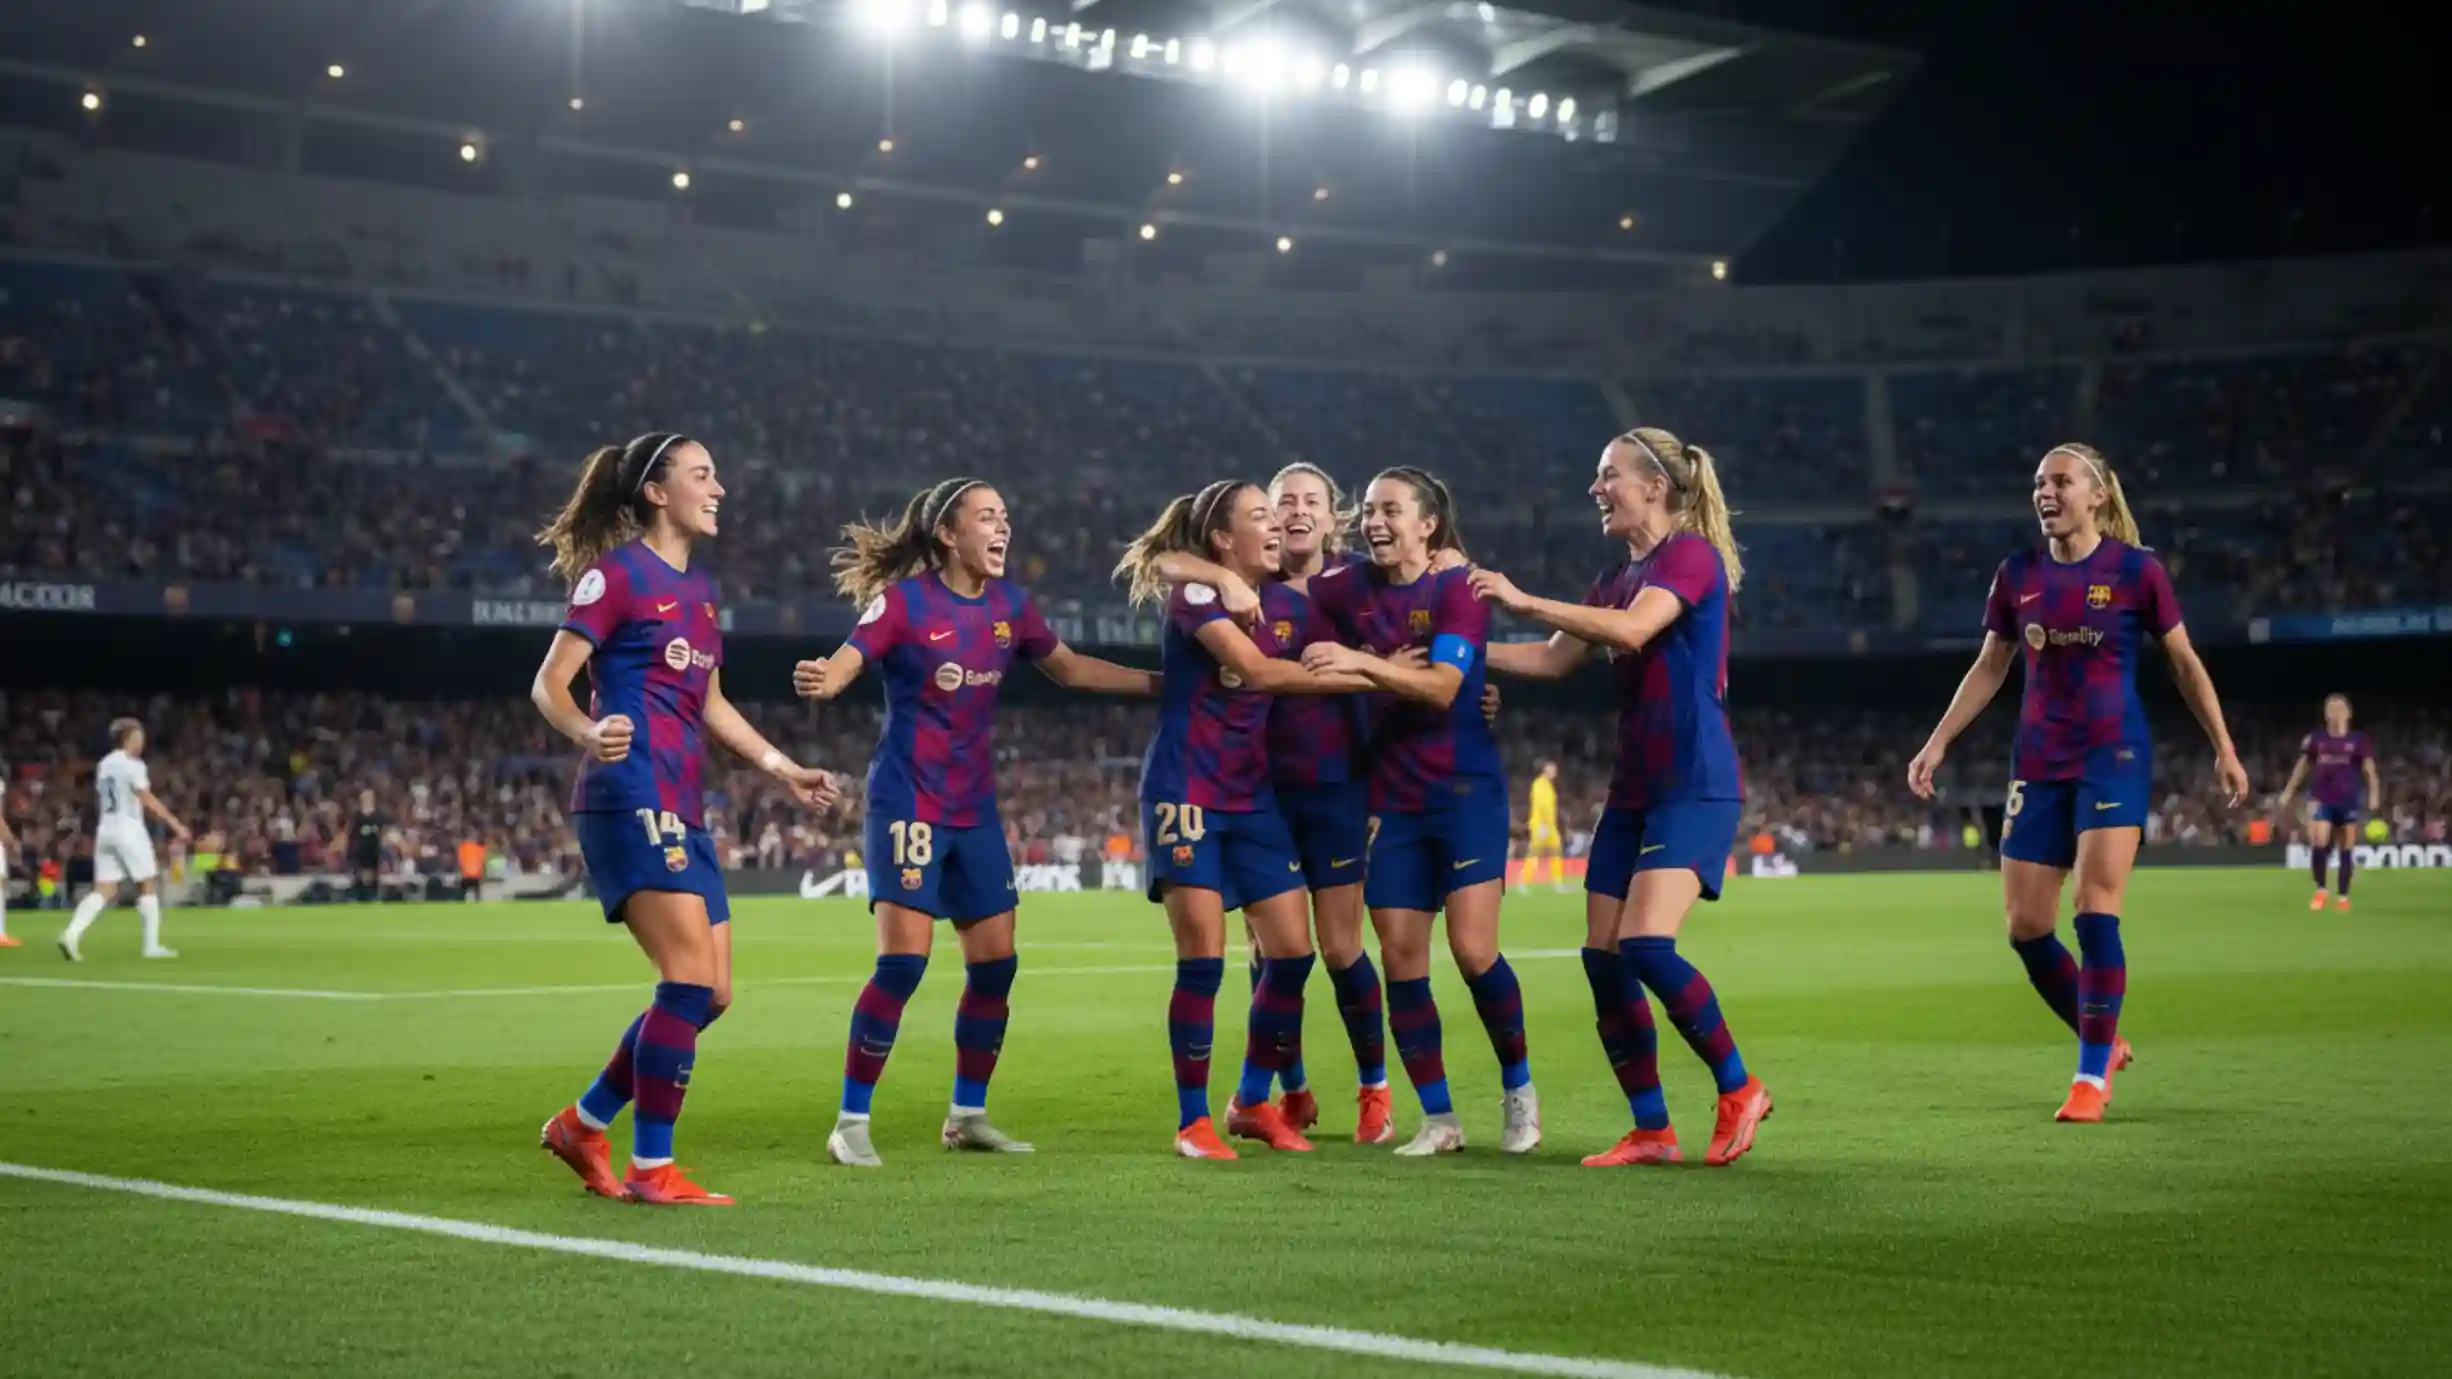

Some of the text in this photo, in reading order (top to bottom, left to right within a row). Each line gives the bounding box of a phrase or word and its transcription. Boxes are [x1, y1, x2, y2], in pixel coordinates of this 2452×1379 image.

[635, 807, 686, 846] 14
[889, 820, 932, 866] 18
[1155, 802, 1206, 846] 20
